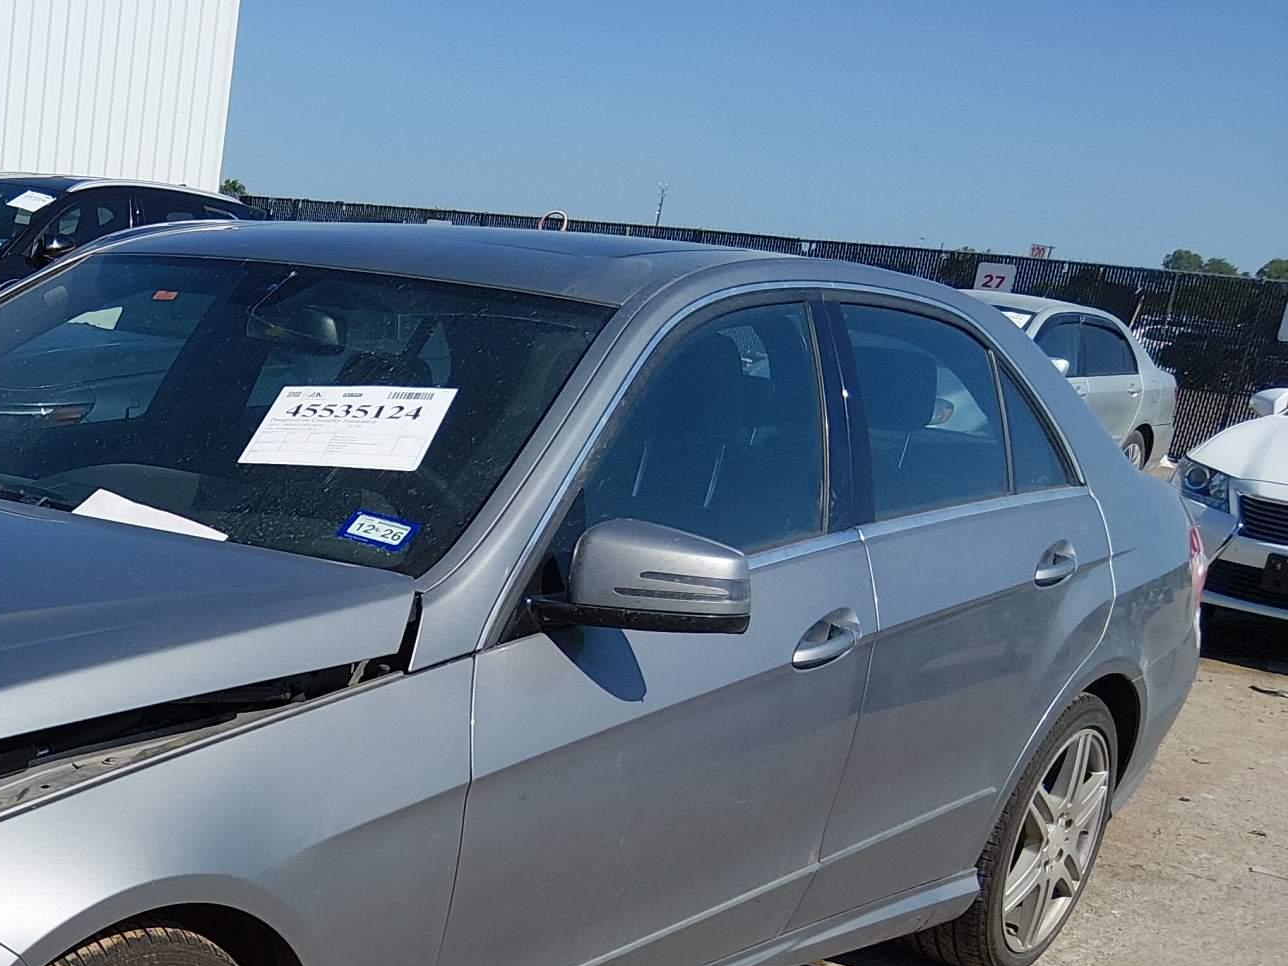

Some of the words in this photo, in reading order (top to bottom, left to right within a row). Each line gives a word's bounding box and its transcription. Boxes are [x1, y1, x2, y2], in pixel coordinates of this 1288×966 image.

[981, 274, 1006, 289] 27
[286, 403, 423, 420] 45535124
[355, 522, 375, 535] 12
[380, 528, 404, 542] 26
